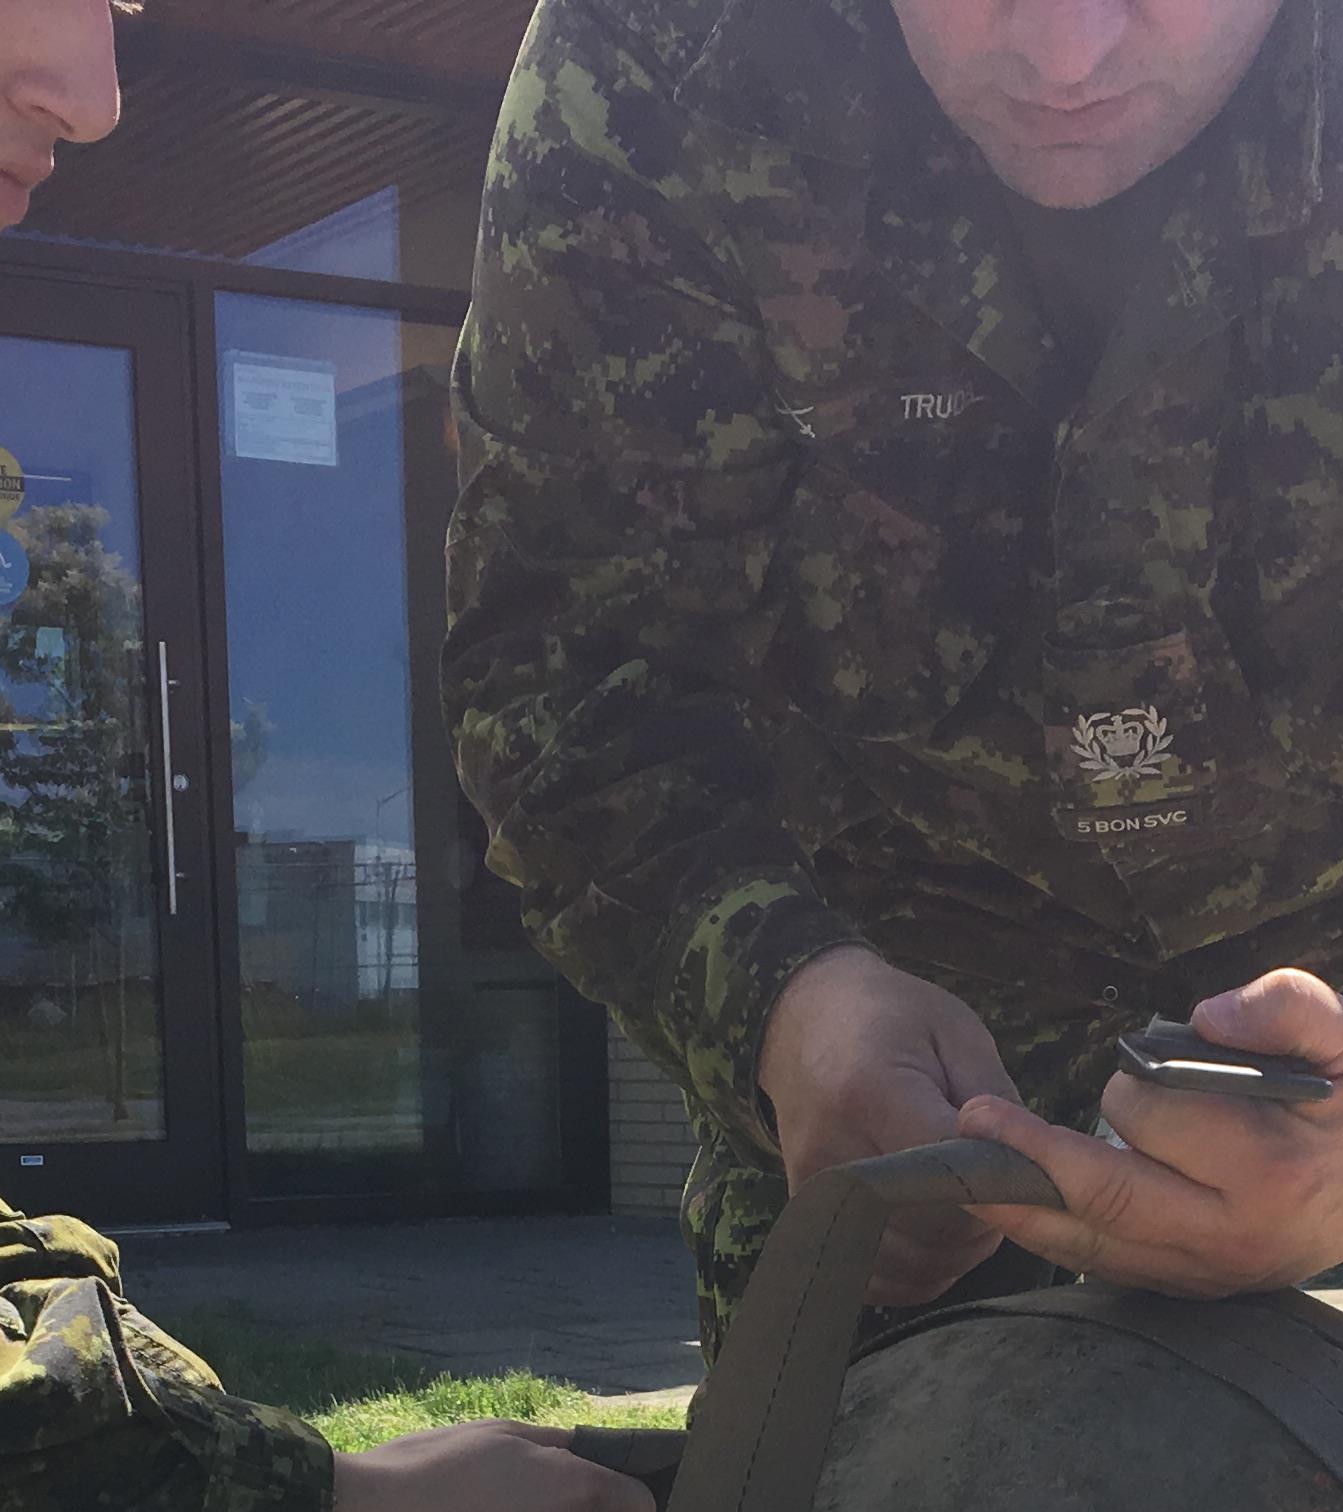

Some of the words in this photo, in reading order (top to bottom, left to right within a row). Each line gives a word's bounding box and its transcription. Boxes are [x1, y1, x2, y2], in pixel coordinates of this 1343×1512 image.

[1077, 821, 1091, 833] 5
[1095, 818, 1140, 833] BON
[1144, 810, 1188, 828] SVC
